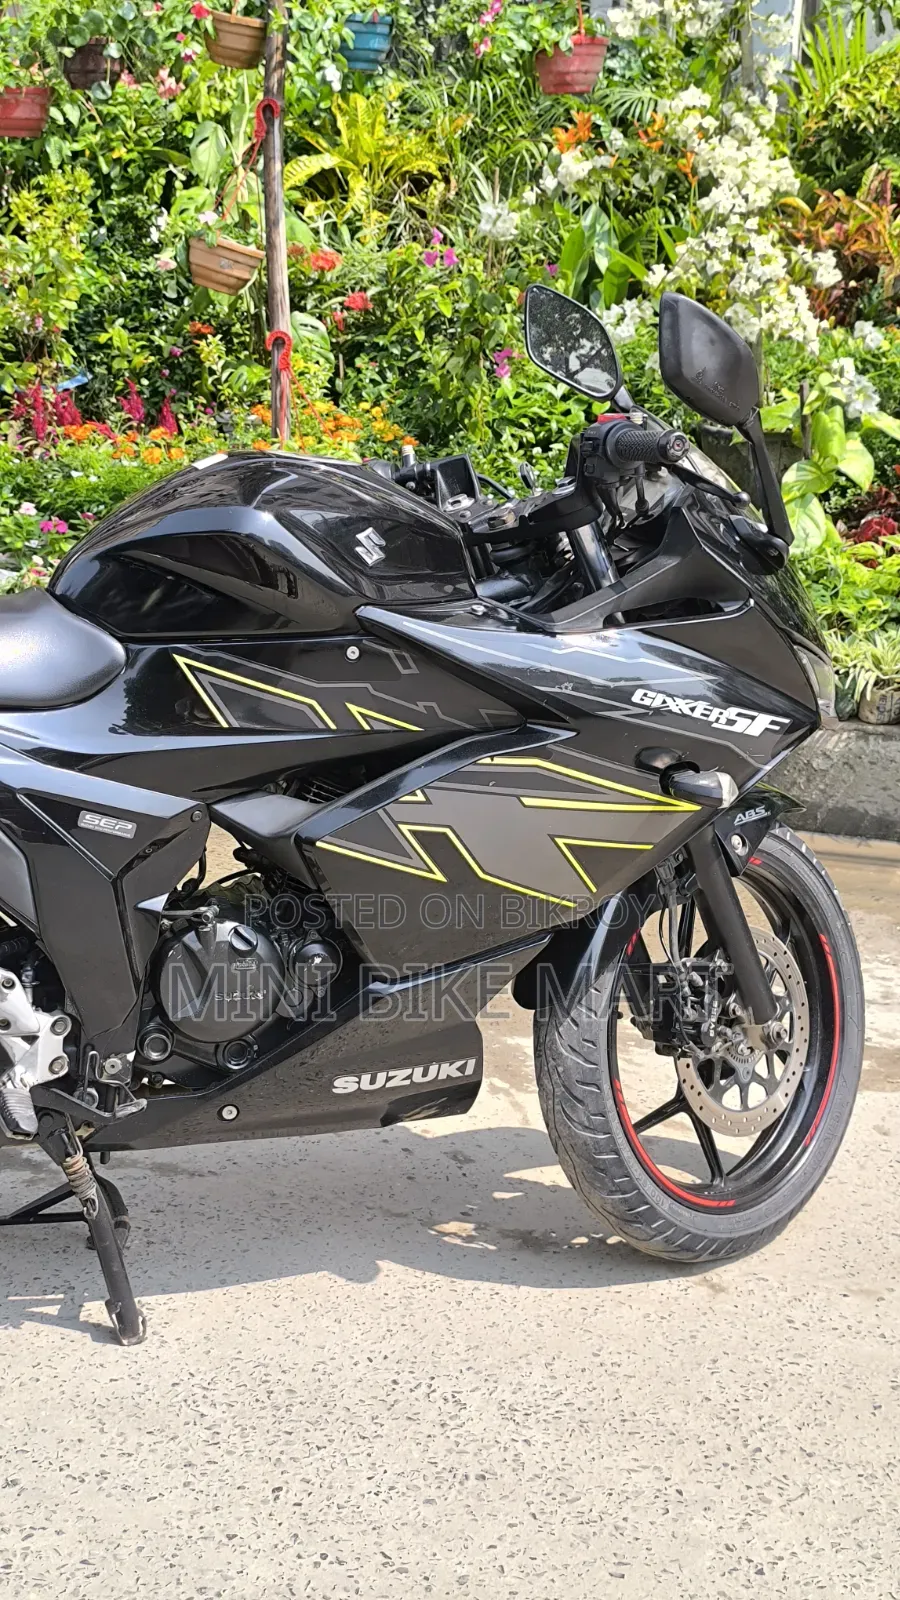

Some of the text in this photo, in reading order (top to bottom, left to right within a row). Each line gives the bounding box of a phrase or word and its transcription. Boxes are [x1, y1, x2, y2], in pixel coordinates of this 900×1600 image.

[82, 813, 133, 831] SEP
[733, 804, 767, 826] ABS
[332, 1058, 476, 1094] SUZUKI
